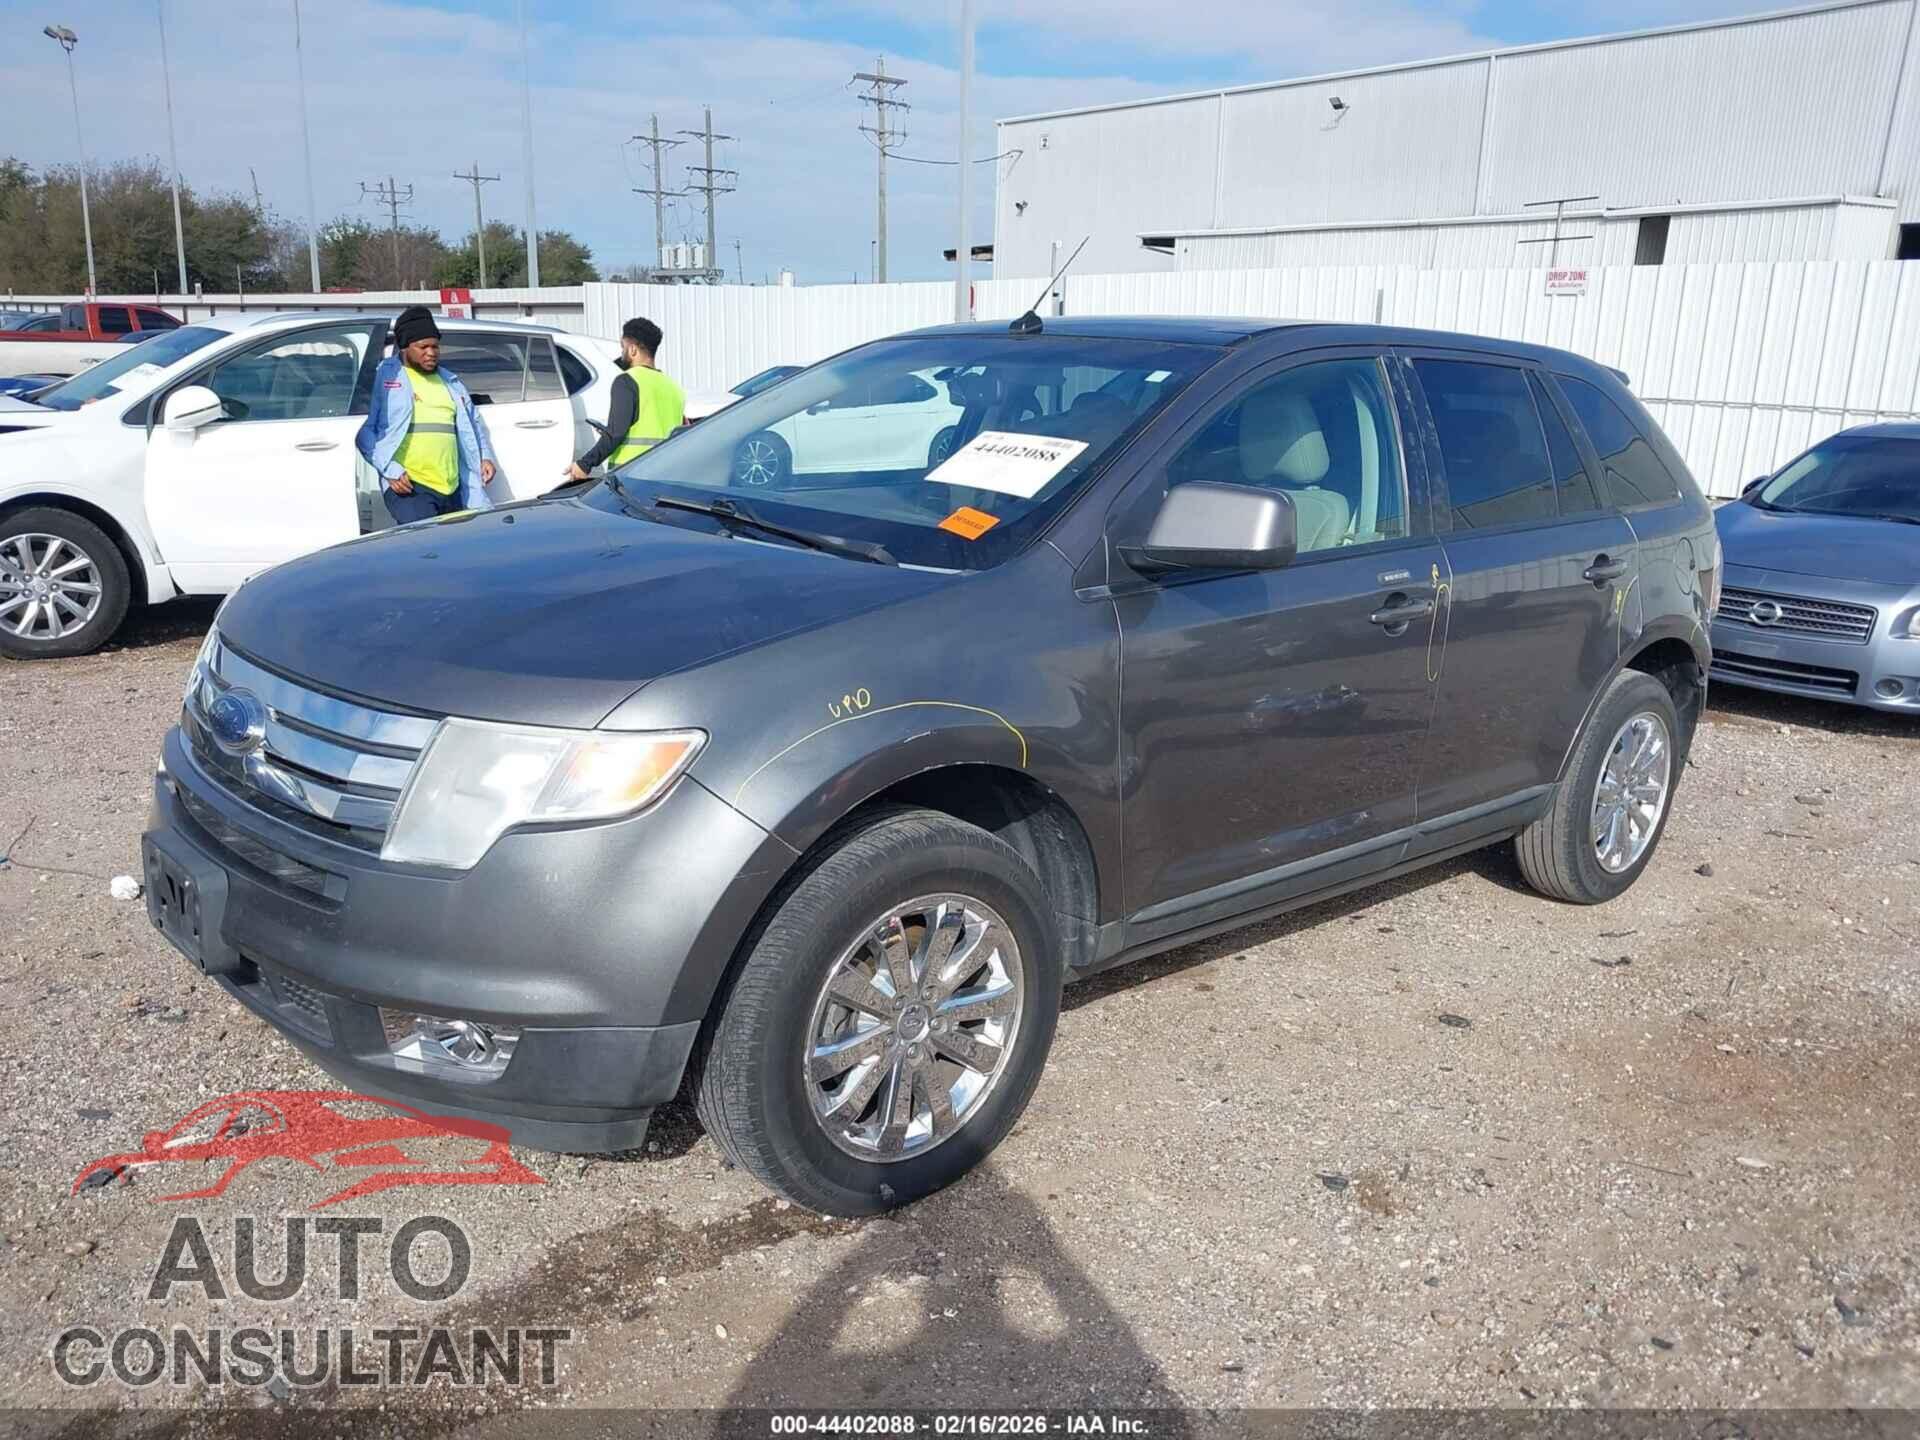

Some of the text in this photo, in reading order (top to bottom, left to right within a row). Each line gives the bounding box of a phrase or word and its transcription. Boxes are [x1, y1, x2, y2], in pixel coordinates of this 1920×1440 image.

[1548, 271, 1587, 281] DROP ZONE
[974, 442, 1061, 461] 44402088
